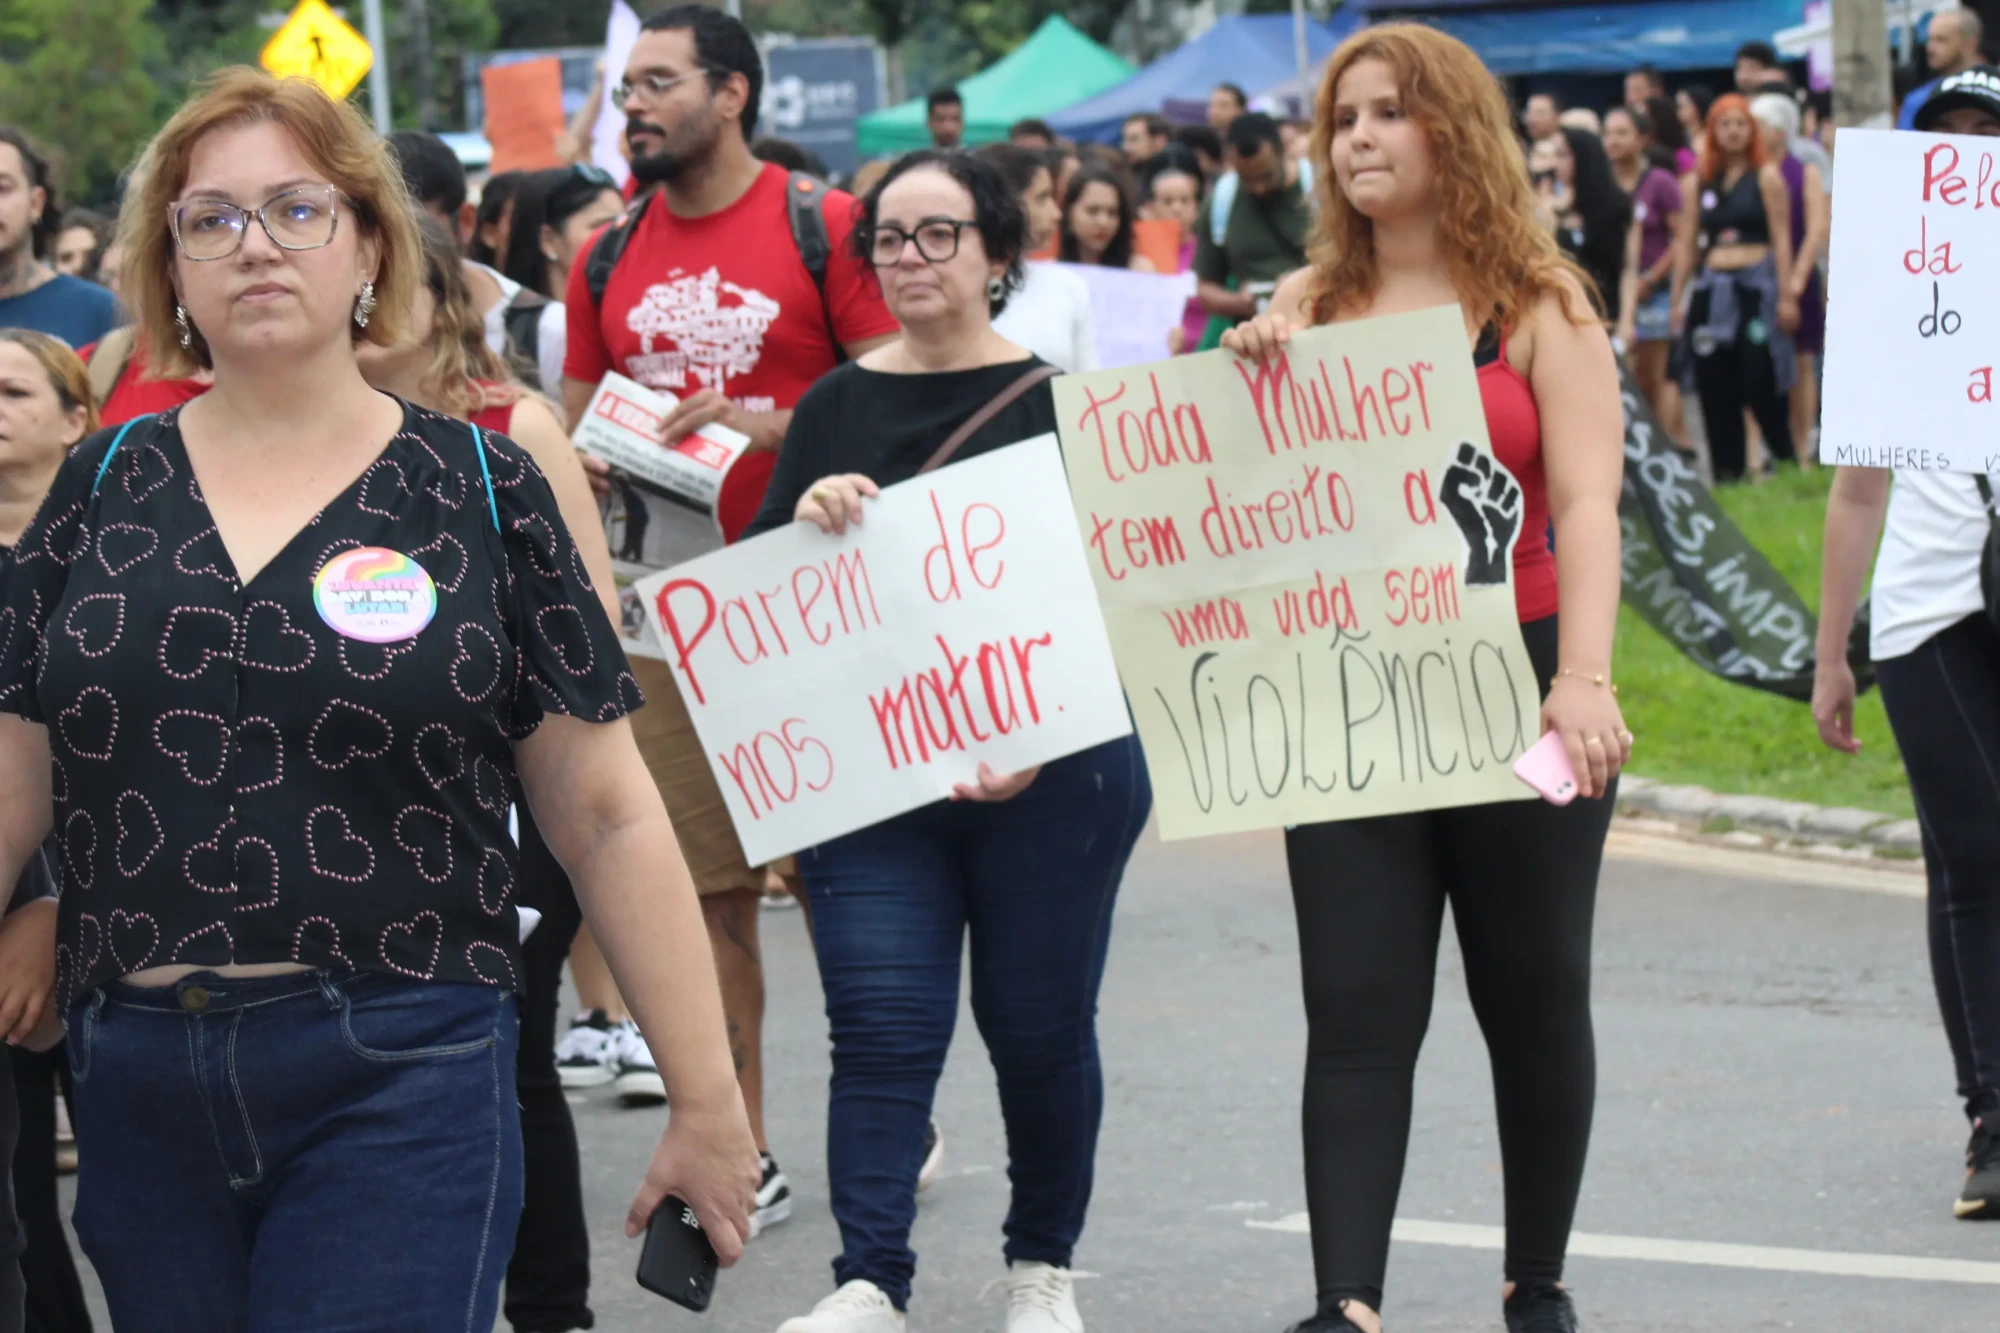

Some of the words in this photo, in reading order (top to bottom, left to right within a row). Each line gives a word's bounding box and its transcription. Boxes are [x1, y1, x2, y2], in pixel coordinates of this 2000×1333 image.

[1903, 214, 1962, 275] da
[1918, 280, 1961, 338] do
[1233, 352, 1434, 455] Mulher
[1966, 365, 1992, 403] a
[1836, 442, 1950, 471] MULHERES
[1090, 511, 1186, 581] tem
[1200, 462, 1355, 559] direito
[1403, 467, 1437, 526] a
[654, 547, 881, 705] Parem
[924, 490, 1005, 603] de
[1162, 597, 1250, 649] uma
[1273, 569, 1359, 638] vida
[1383, 561, 1461, 627] sem
[718, 718, 834, 820] nos
[868, 631, 1065, 770] matar.
